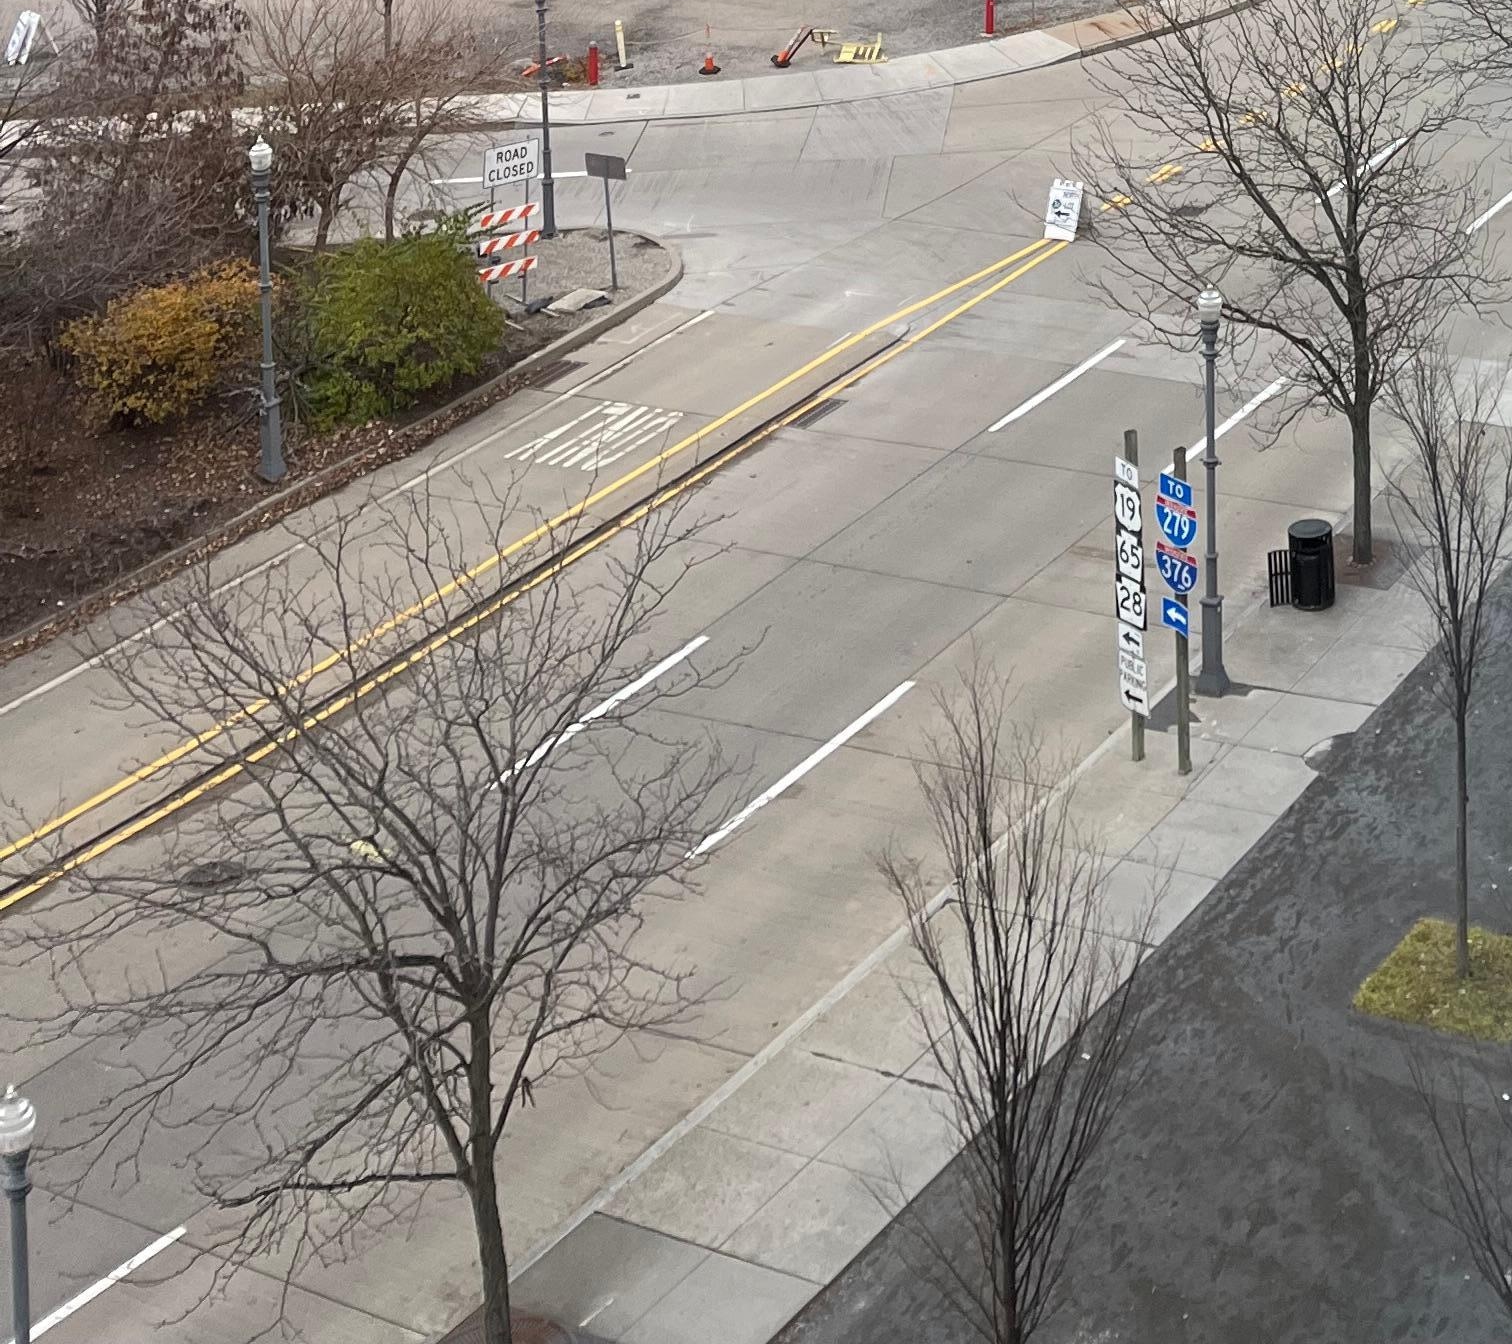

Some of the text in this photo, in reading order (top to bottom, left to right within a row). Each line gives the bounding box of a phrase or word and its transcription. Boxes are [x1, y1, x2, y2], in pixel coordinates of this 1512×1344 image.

[496, 147, 527, 163] ROAD
[488, 161, 534, 182] CLOSED
[1121, 463, 1133, 480] TO
[1167, 480, 1184, 499] TO
[1121, 493, 1136, 519] 19
[1163, 507, 1190, 540] 279
[1120, 542, 1140, 570] 65
[1161, 555, 1192, 586] 376
[1120, 586, 1143, 617] 28
[1121, 655, 1144, 677] PUBLIC
